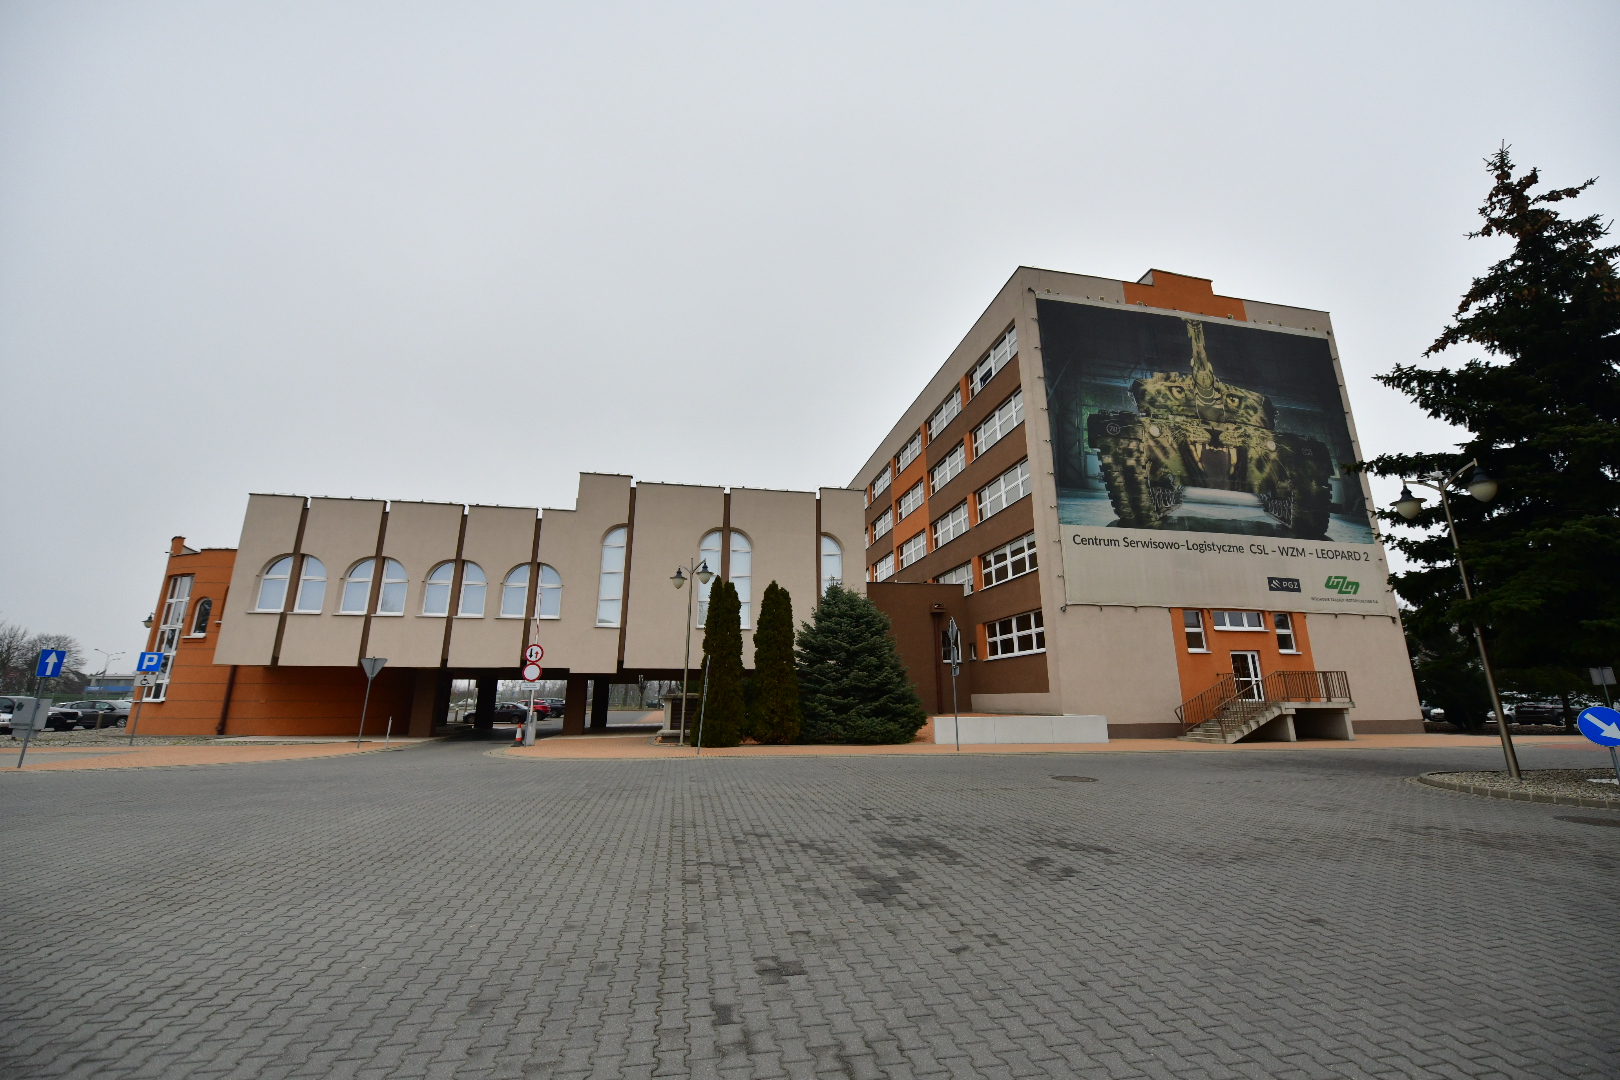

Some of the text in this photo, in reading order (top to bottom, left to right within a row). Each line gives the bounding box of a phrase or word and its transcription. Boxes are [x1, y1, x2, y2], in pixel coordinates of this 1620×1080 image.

[1072, 534, 1120, 547] Centrum
[1122, 536, 1245, 554] Serwisowo-Logistyczne
[1249, 543, 1269, 556] CSL
[1278, 545, 1306, 558] WZM
[1315, 548, 1361, 561] LEOPARD
[1364, 551, 1370, 562] 2
[1282, 581, 1299, 589] PGZ
[142, 654, 159, 670] P
